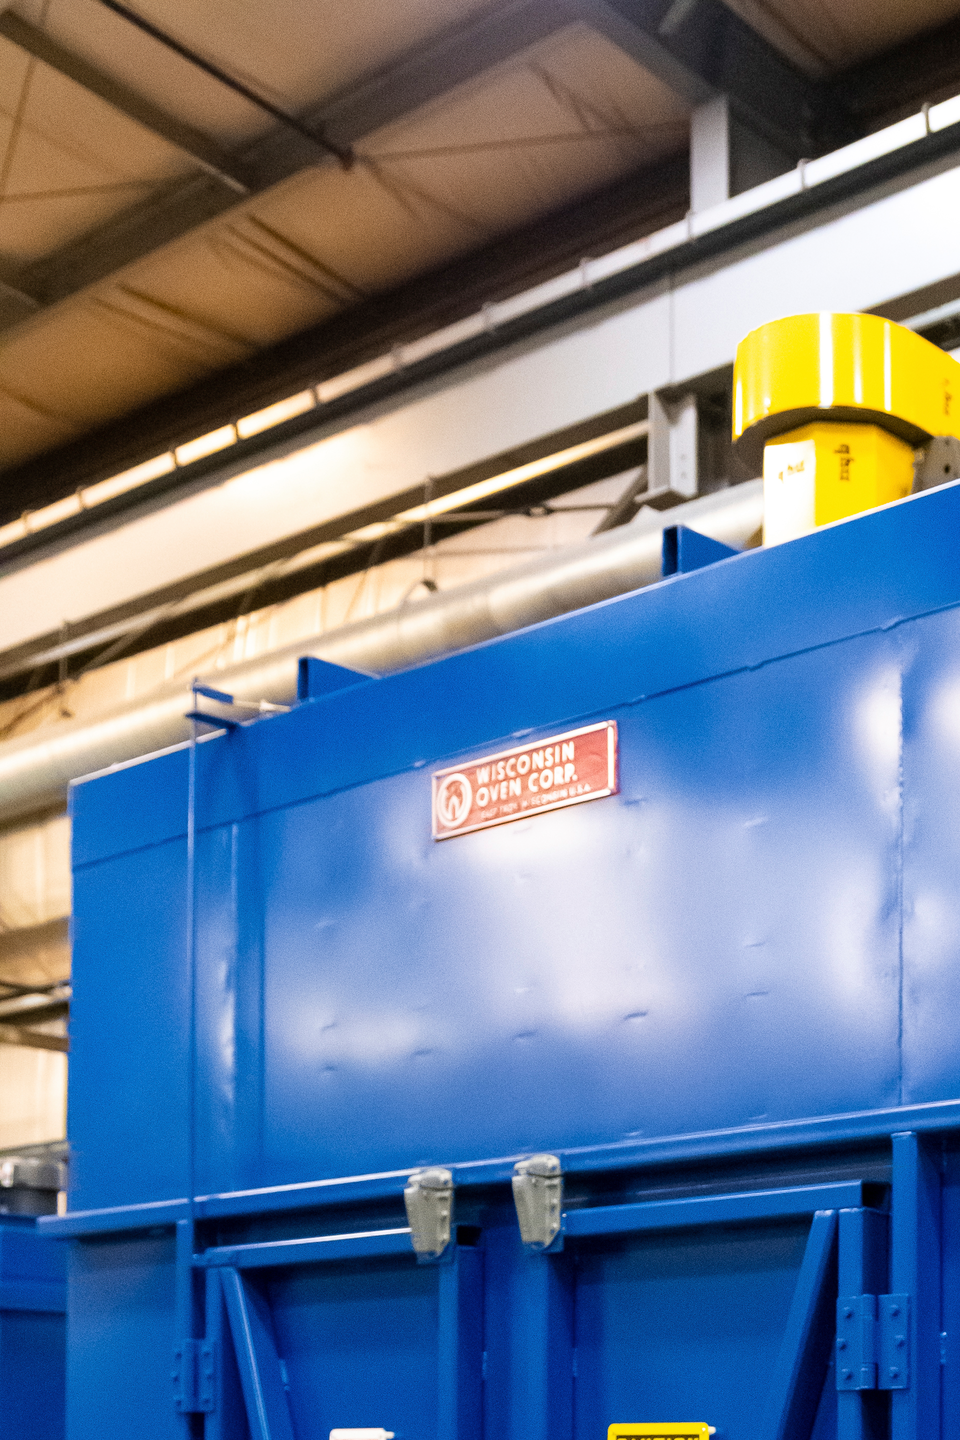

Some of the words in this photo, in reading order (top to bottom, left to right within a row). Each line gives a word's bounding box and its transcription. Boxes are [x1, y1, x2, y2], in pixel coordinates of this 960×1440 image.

[476, 741, 575, 785] WISCONSIN
[476, 777, 522, 807] OVEN
[528, 763, 578, 793] CORP.
